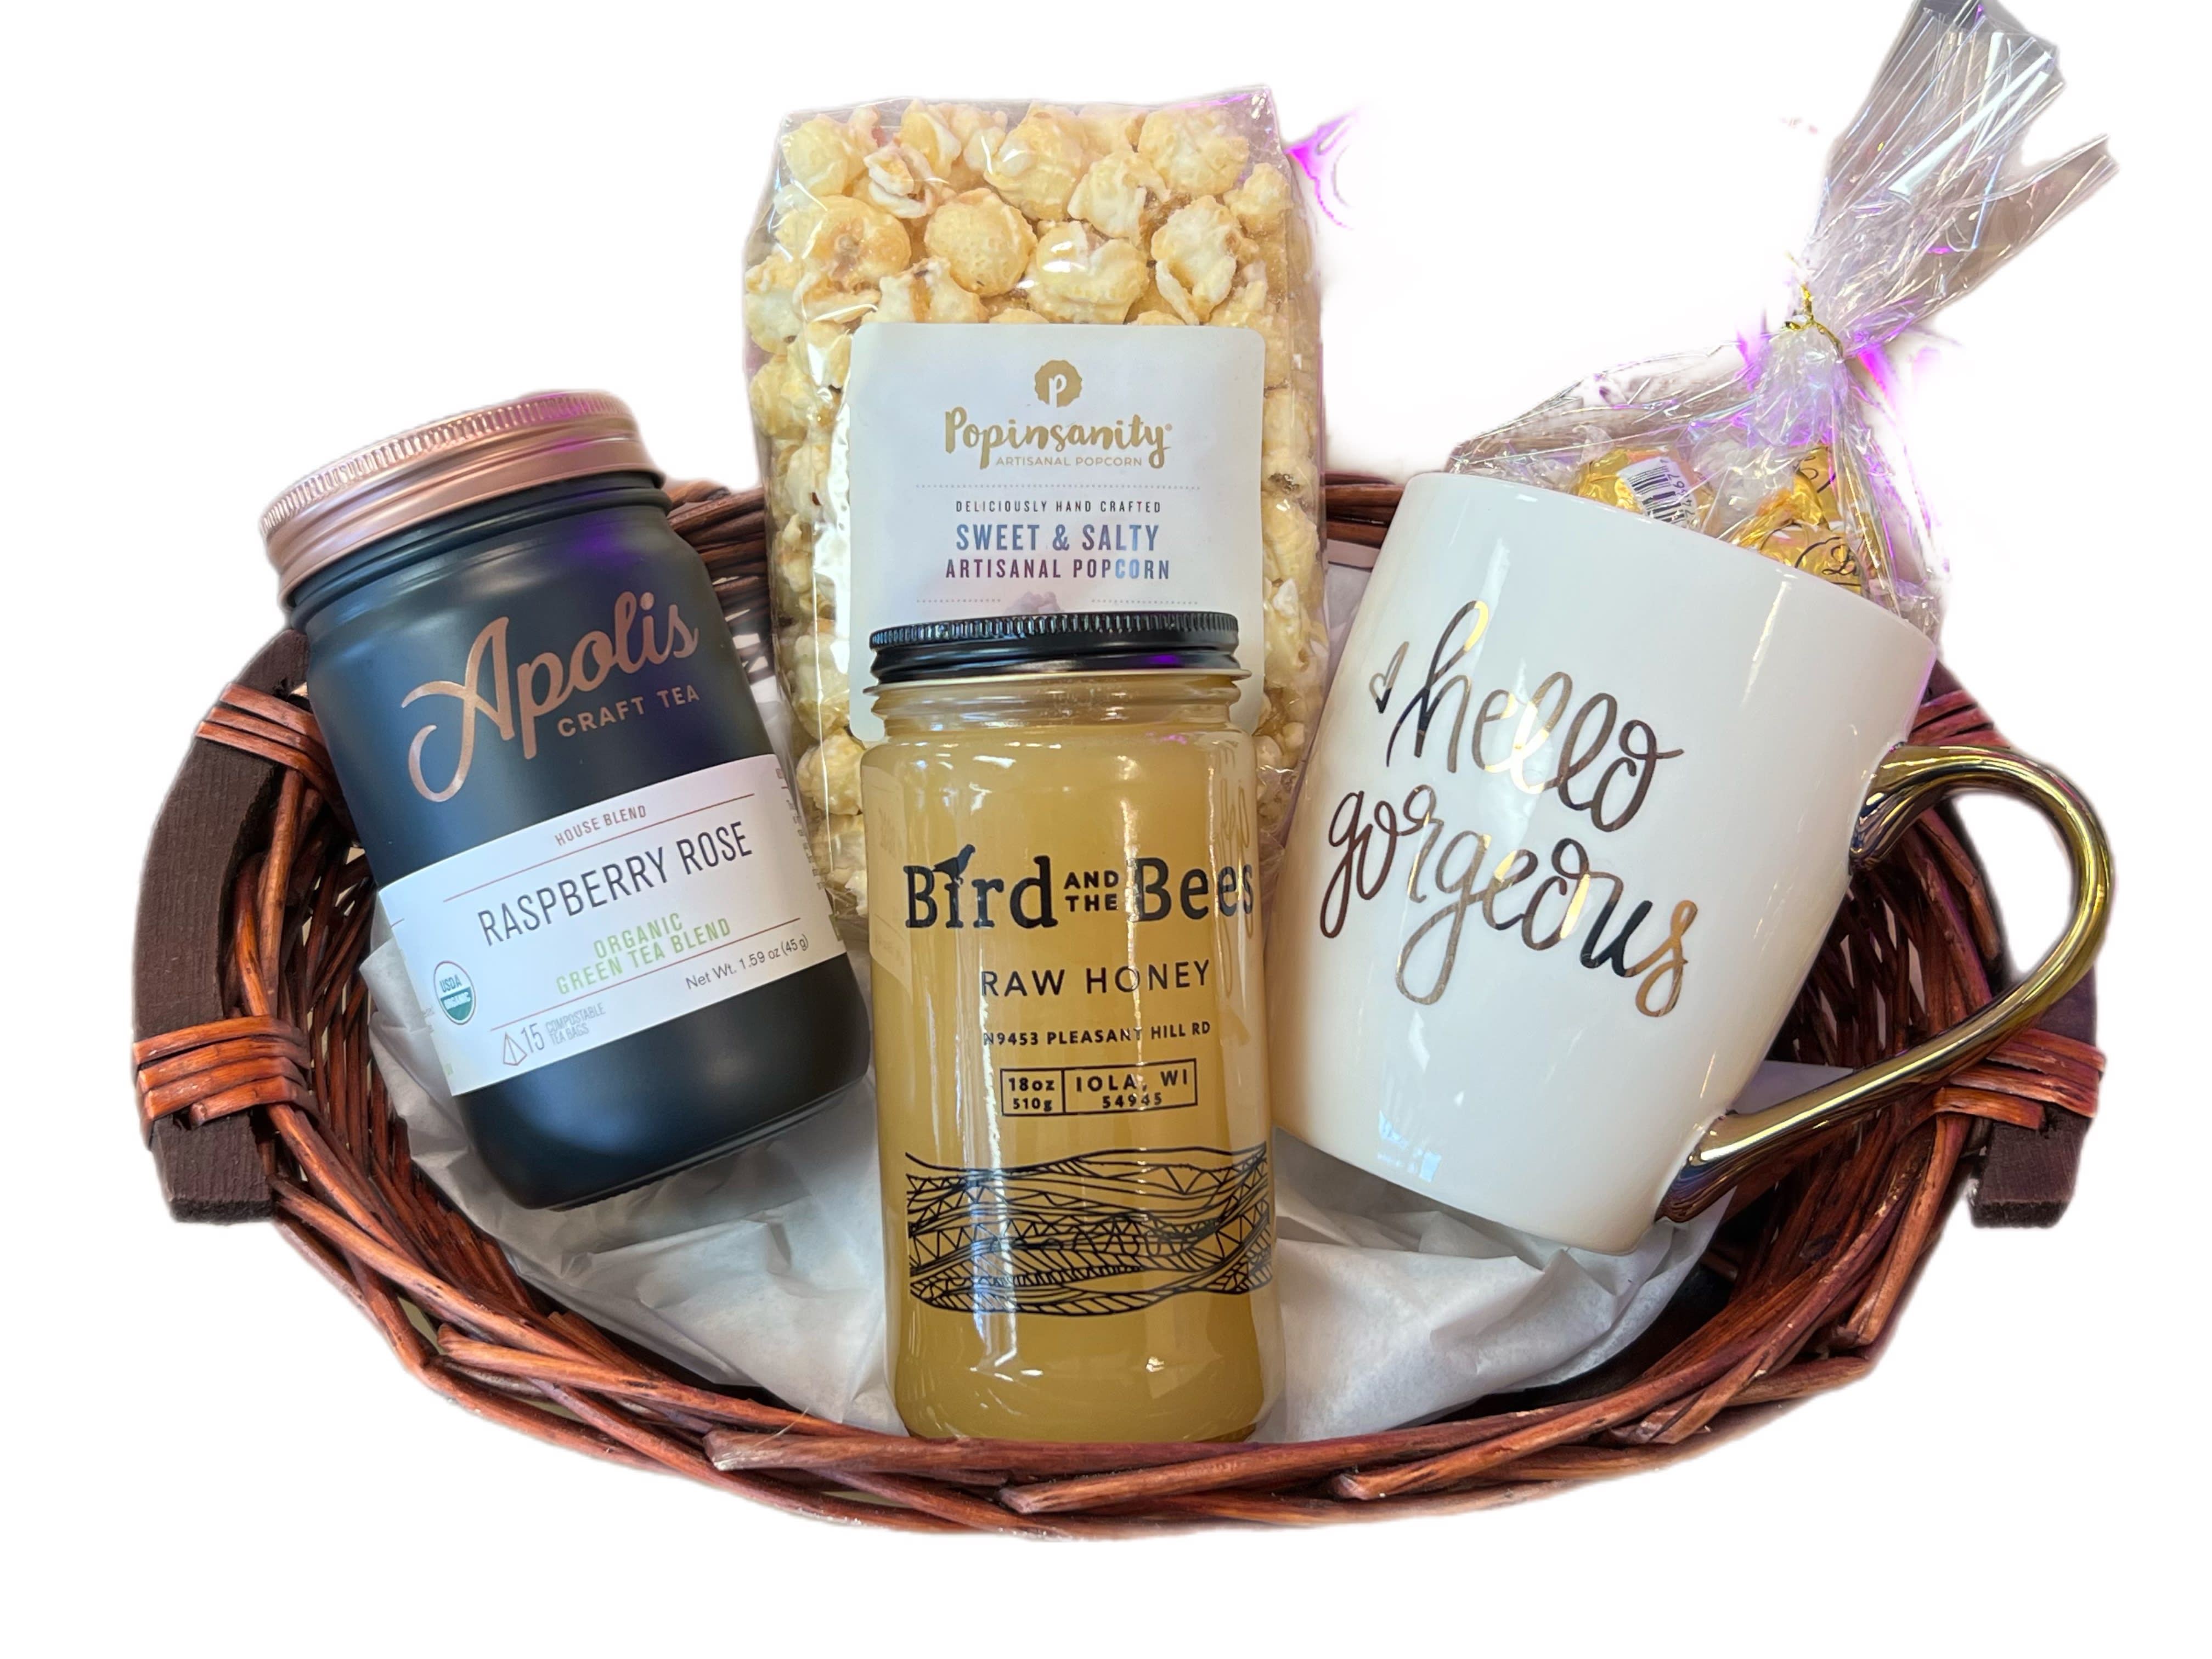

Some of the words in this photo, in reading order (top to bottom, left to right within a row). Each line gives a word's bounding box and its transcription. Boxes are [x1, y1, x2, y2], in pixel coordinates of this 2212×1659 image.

[995, 456, 1071, 467] ARTISANAL
[1075, 456, 1143, 466] POPCORN
[956, 500, 1047, 513] DELICIOUSLY
[1056, 500, 1092, 512] HAND
[1100, 500, 1161, 514] CRAFTED
[956, 523, 1040, 551] SWEET
[1052, 523, 1070, 551] &
[1081, 524, 1159, 551] SALTY
[945, 558, 1062, 579] ARTISANAL
[1073, 558, 1170, 580] POPCORN
[401, 591, 699, 802] Apolis
[556, 696, 645, 737] CRAFT
[657, 684, 700, 709] TEA
[1386, 600, 1685, 832] hello
[554, 816, 601, 846] HOUSE
[603, 804, 647, 827] BLEND
[477, 846, 668, 947] RASPBERRY
[675, 821, 753, 875] ROSE
[903, 855, 1058, 929] Bird
[1063, 870, 1120, 889] AND
[1128, 857, 1254, 923] Bees
[1065, 893, 1118, 912] THE
[1320, 784, 1699, 1018] gorgeous
[592, 912, 684, 960] ORGANIC
[555, 956, 623, 995] GREEN
[628, 941, 666, 969] TEA
[670, 917, 731, 954] BLEND
[685, 973, 712, 990] Net
[712, 963, 737, 980] Wt.
[738, 950, 766, 970] 1.59
[768, 947, 780, 961] oz
[439, 974, 462, 993] USDA
[981, 969, 1065, 997] RAW
[1086, 960, 1209, 994] HONEY
[545, 1002, 606, 1034] COMPOSTABLE
[983, 1031, 1039, 1046] N9453
[1047, 1026, 1143, 1045] PLEASANT
[1151, 1023, 1186, 1040] HILL
[1191, 1021, 1211, 1035] RD
[521, 1022, 545, 1053] 15
[549, 1030, 567, 1046] TEA
[566, 1022, 590, 1042] BAGS
[1008, 1077, 1055, 1092] 18oz
[1075, 1073, 1148, 1093] IOLA,
[1160, 1069, 1188, 1086] WI
[1012, 1097, 1052, 1112] 510g
[1102, 1092, 1163, 1109] 54945
